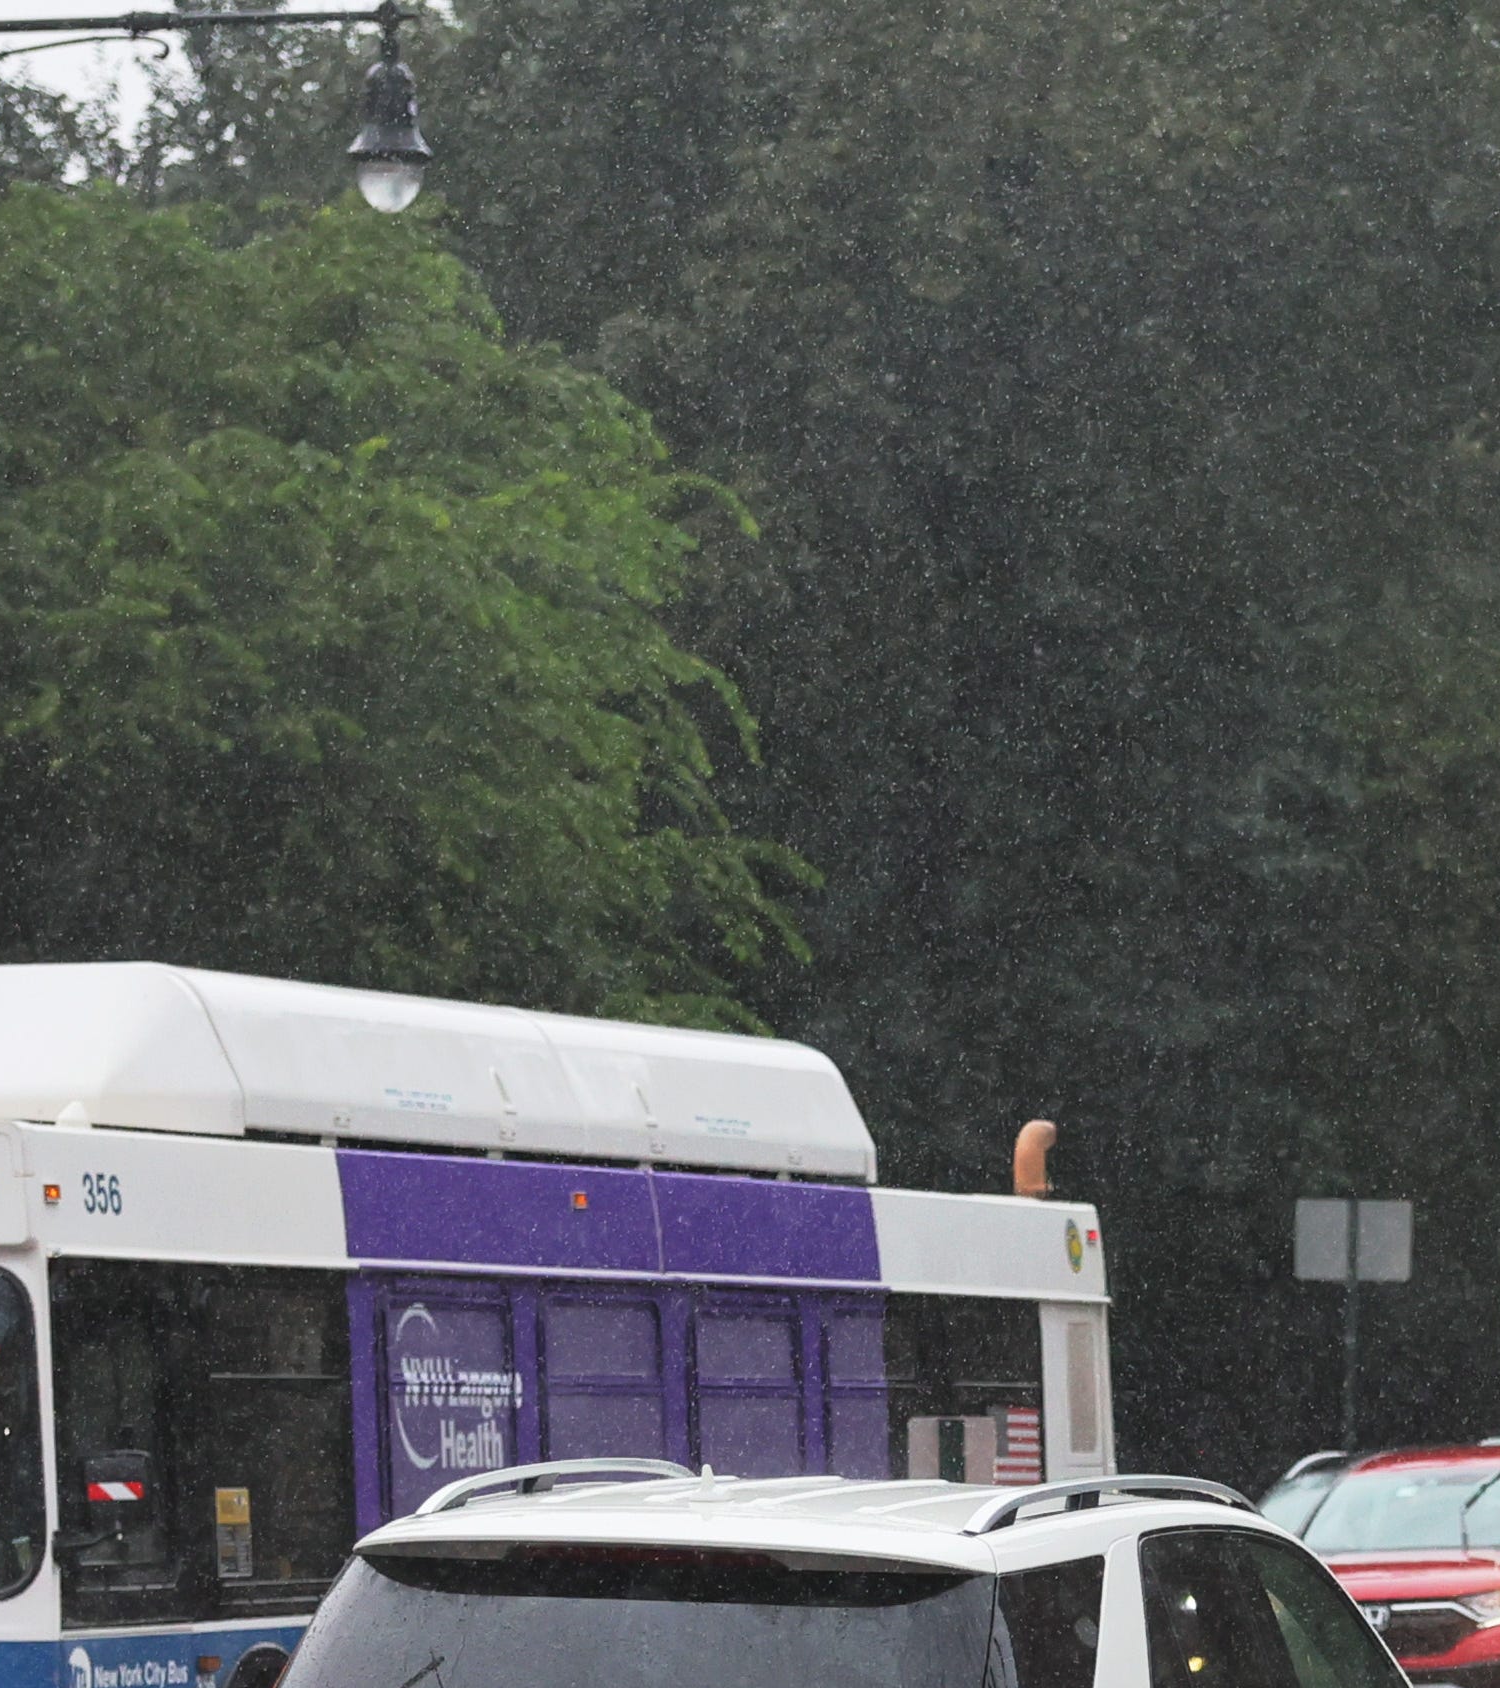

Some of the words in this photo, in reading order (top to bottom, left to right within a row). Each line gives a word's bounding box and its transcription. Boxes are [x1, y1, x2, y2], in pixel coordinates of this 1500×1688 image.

[82, 1172, 122, 1215] 356
[440, 1419, 504, 1469] Health
[94, 1665, 118, 1688] New
[119, 1662, 144, 1688] York
[167, 1659, 188, 1685] Bus
